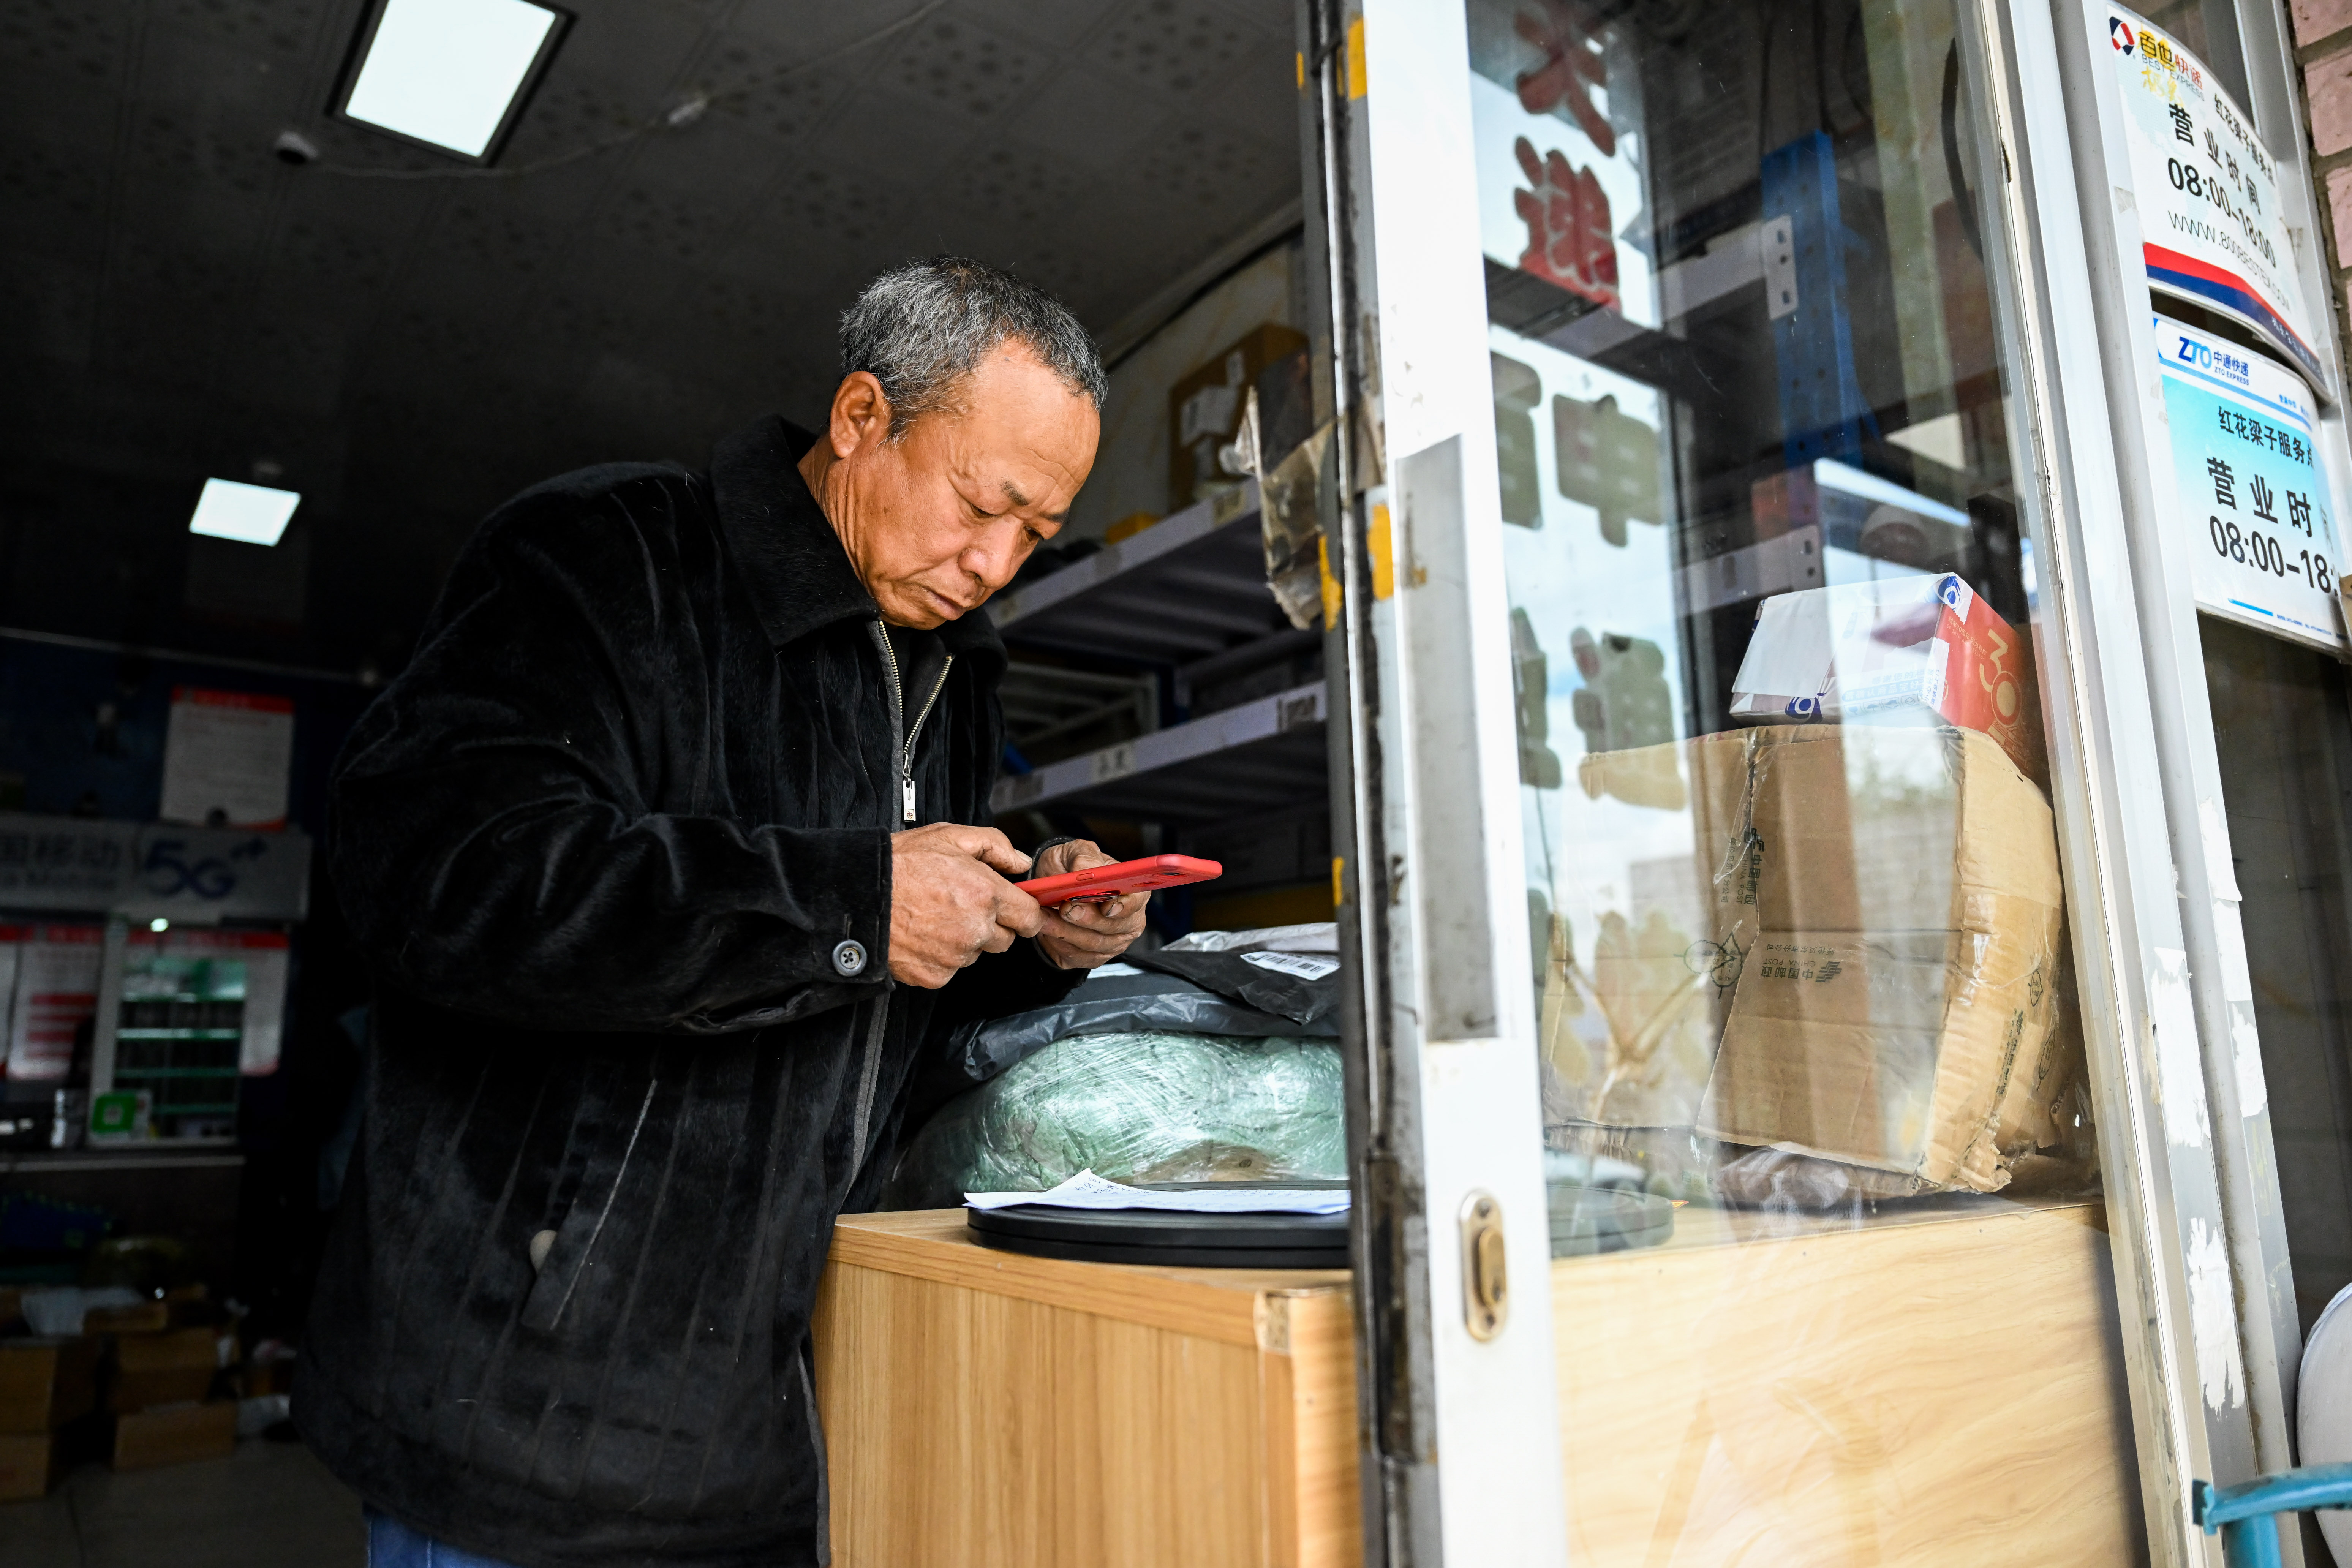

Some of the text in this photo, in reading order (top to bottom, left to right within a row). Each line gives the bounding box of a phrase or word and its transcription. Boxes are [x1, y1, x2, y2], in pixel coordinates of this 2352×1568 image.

[2139, 32, 2203, 90] 百世快递
[2142, 54, 2205, 101] BEST EXPRESS
[2169, 103, 2261, 215] 营业时间
[2168, 158, 2276, 268] 08:00-18:00
[2178, 336, 2212, 369] ZTO
[2214, 351, 2248, 376] 中通快递
[2214, 366, 2249, 386] ZTO EXPRESS
[2218, 406, 2314, 469] 红花梁子服务点
[1948, 616, 1987, 655] 顺丰30周年 因为有你
[1740, 854, 1748, 879] CHINA
[1744, 855, 1762, 905] 中国邮政
[1767, 944, 1835, 955] 呼伦贝尔市分公司
[1761, 966, 1814, 980] 中国邮政
